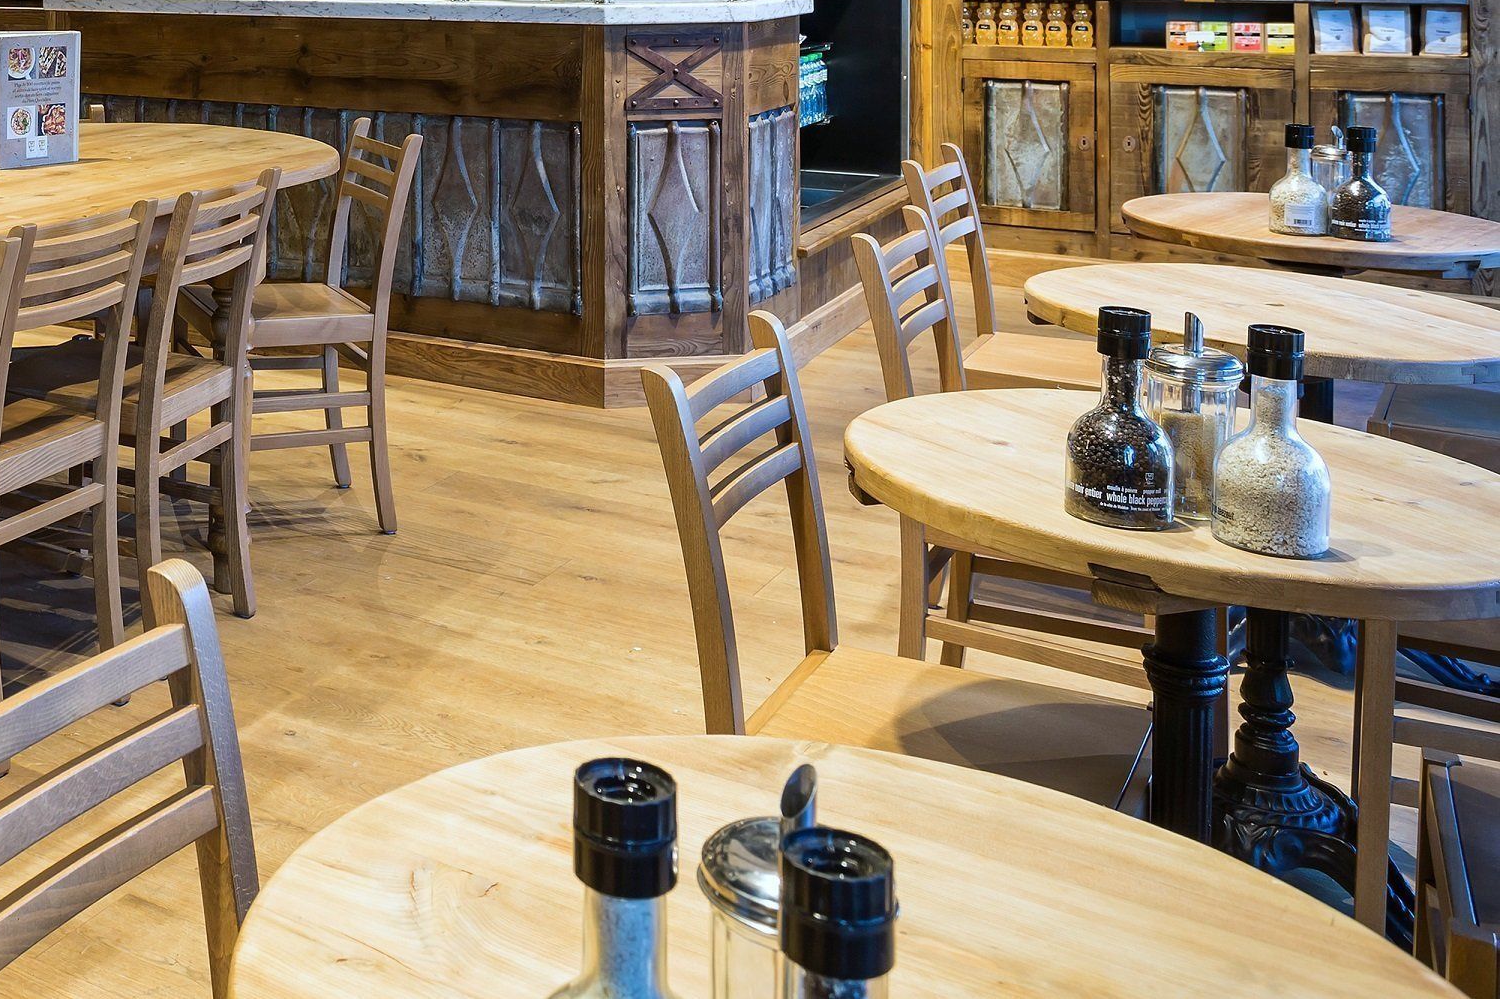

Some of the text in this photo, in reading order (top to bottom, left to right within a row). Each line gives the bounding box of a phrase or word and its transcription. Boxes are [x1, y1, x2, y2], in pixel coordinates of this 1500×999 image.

[1075, 483, 1084, 494] noir
[1085, 487, 1102, 499] entier
[1106, 491, 1127, 504] whole
[1128, 494, 1146, 505] black
